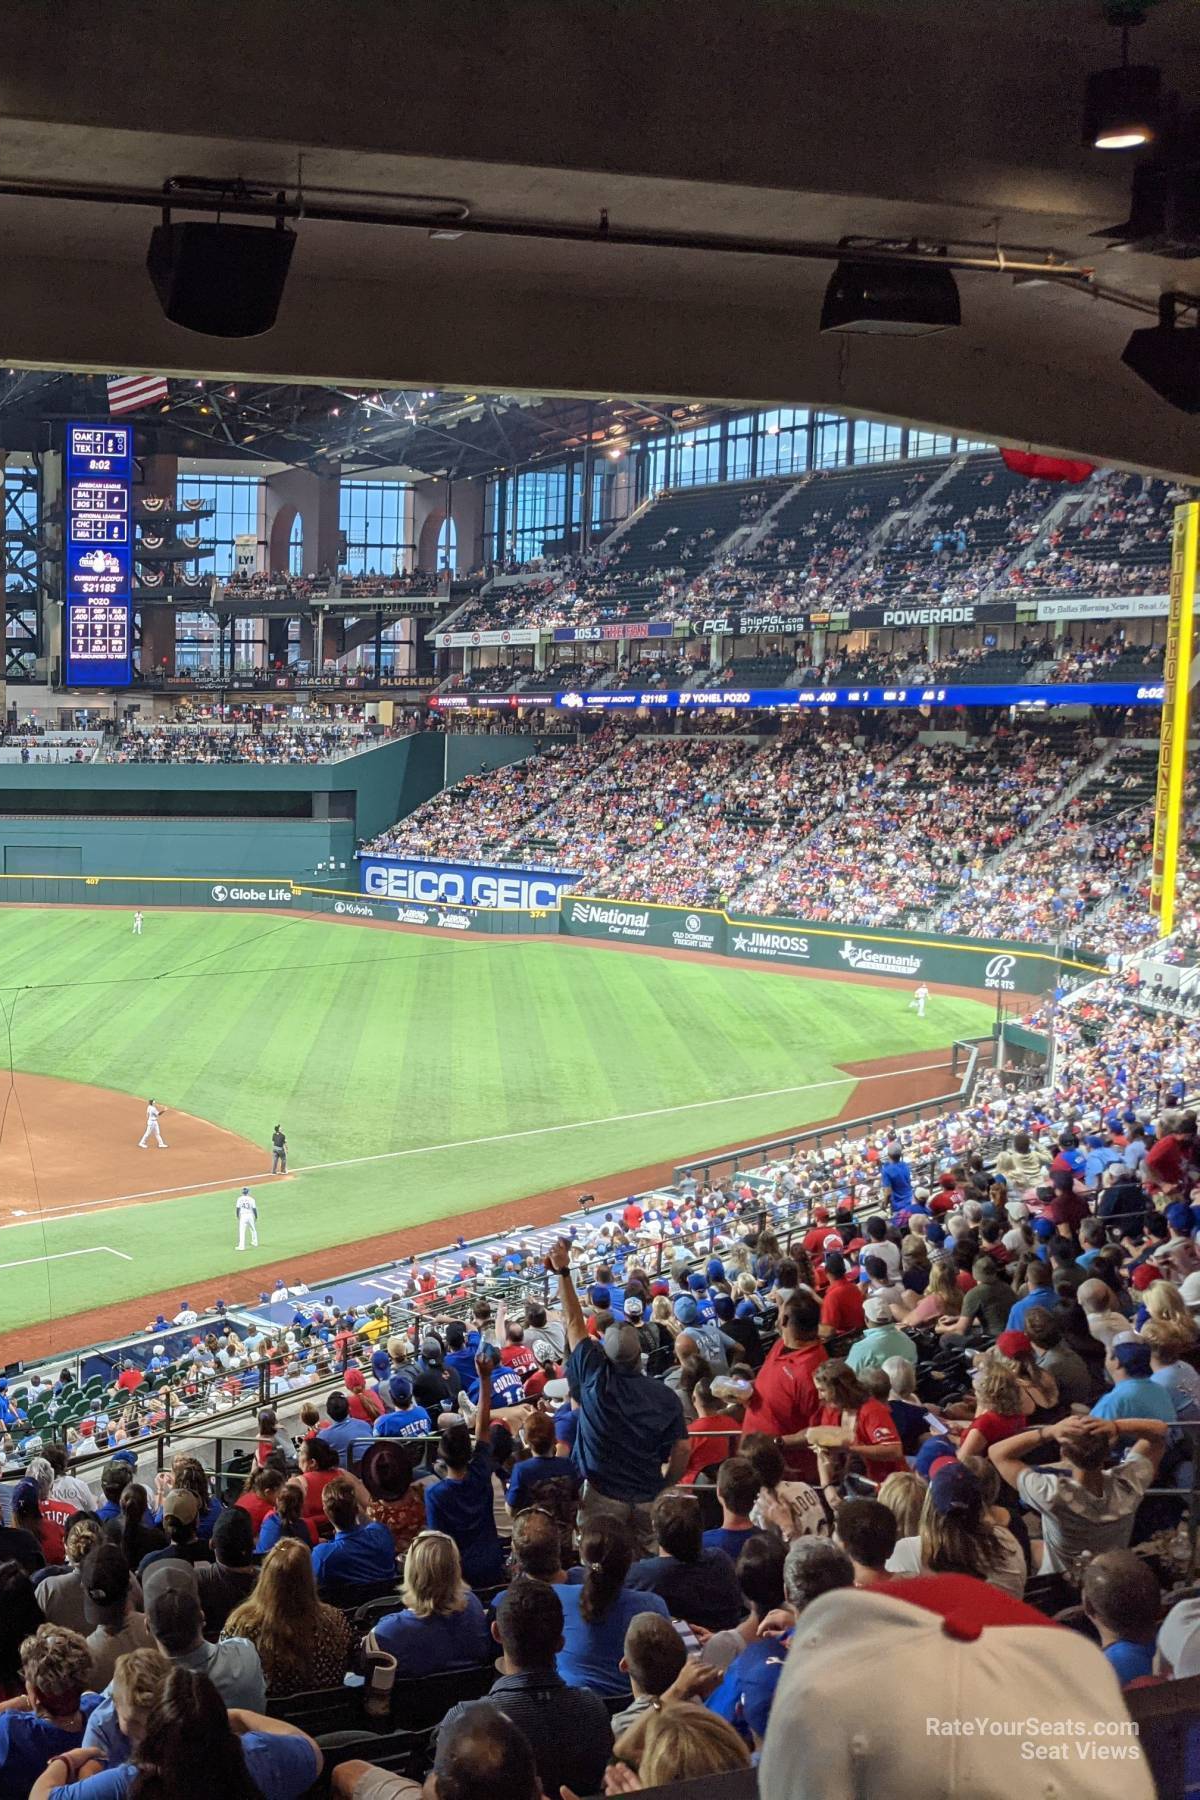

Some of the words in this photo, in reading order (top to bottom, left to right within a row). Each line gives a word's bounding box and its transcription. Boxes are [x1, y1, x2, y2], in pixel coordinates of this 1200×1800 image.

[90, 460, 110, 469] 8:02
[82, 583, 116, 592] $21185
[1172, 552, 1183, 619] THE
[1043, 606, 1055, 614] The
[1058, 605, 1078, 613] Dallas
[1080, 605, 1110, 613] Morning
[1111, 603, 1129, 611] News
[740, 616, 804, 626] ShipPGL.com
[884, 608, 974, 626] POWERADE
[574, 628, 600, 639] 105.3
[602, 626, 624, 639] THE
[626, 624, 648, 638] FAN
[703, 620, 733, 632] PGL
[740, 624, 804, 634] 877.701.1919
[1166, 638, 1178, 704] HOT
[380, 677, 440, 686] PLUCKERS
[641, 695, 668, 704] $21185
[692, 694, 721, 703] YOHEL
[723, 693, 750, 703] POZO
[816, 692, 837, 702] .400
[862, 692, 868, 701] 1
[898, 691, 905, 701] 3
[937, 690, 945, 700] 5
[1137, 688, 1164, 699] 8:02
[1158, 722, 1172, 812] ZONE
[366, 866, 465, 904] GEICO
[230, 888, 266, 901] Globe
[268, 888, 292, 901] Life
[346, 903, 374, 916] Kubota
[588, 905, 648, 927] National
[622, 927, 646, 937] Rental
[684, 933, 714, 941] DOMINION
[674, 939, 697, 947] FREIGHT
[862, 950, 922, 968] Germania
